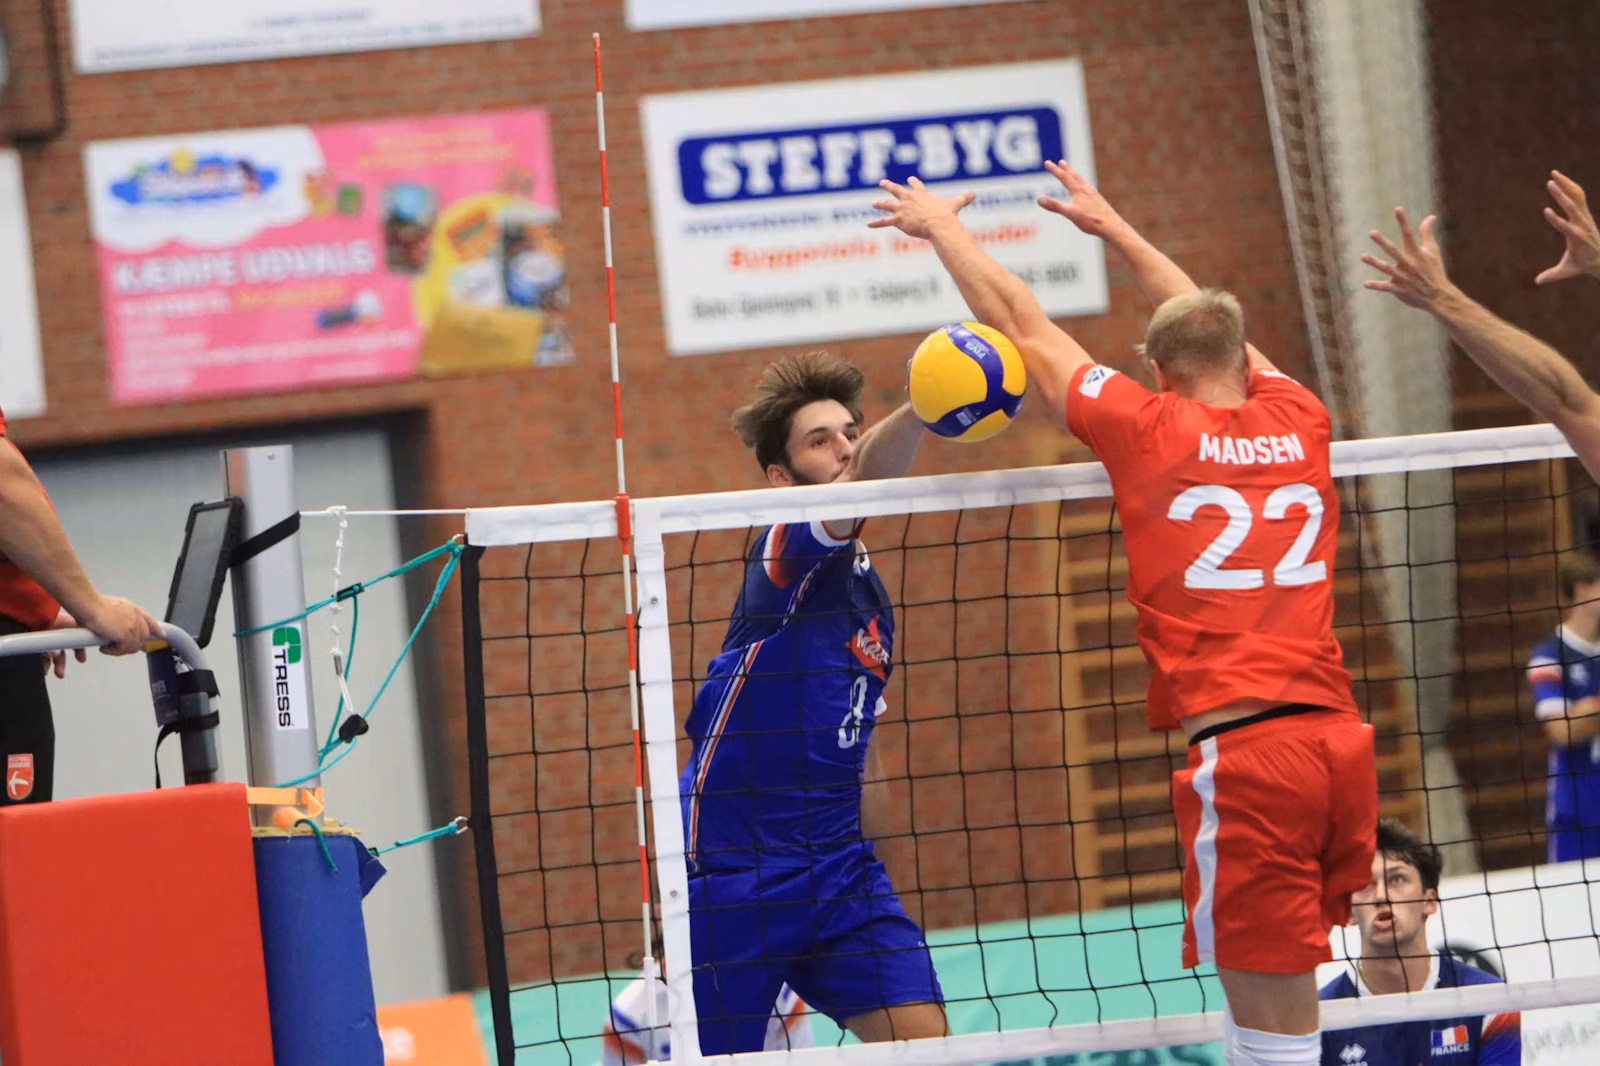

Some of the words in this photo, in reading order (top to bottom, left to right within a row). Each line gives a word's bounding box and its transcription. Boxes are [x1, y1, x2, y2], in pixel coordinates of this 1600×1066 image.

[699, 113, 1045, 200] STEFF-BYG
[1198, 432, 1306, 465] MADSEN
[1167, 483, 1328, 590] 22
[273, 649, 292, 728] TRESS
[1430, 1043, 1471, 1057] FRANCE
